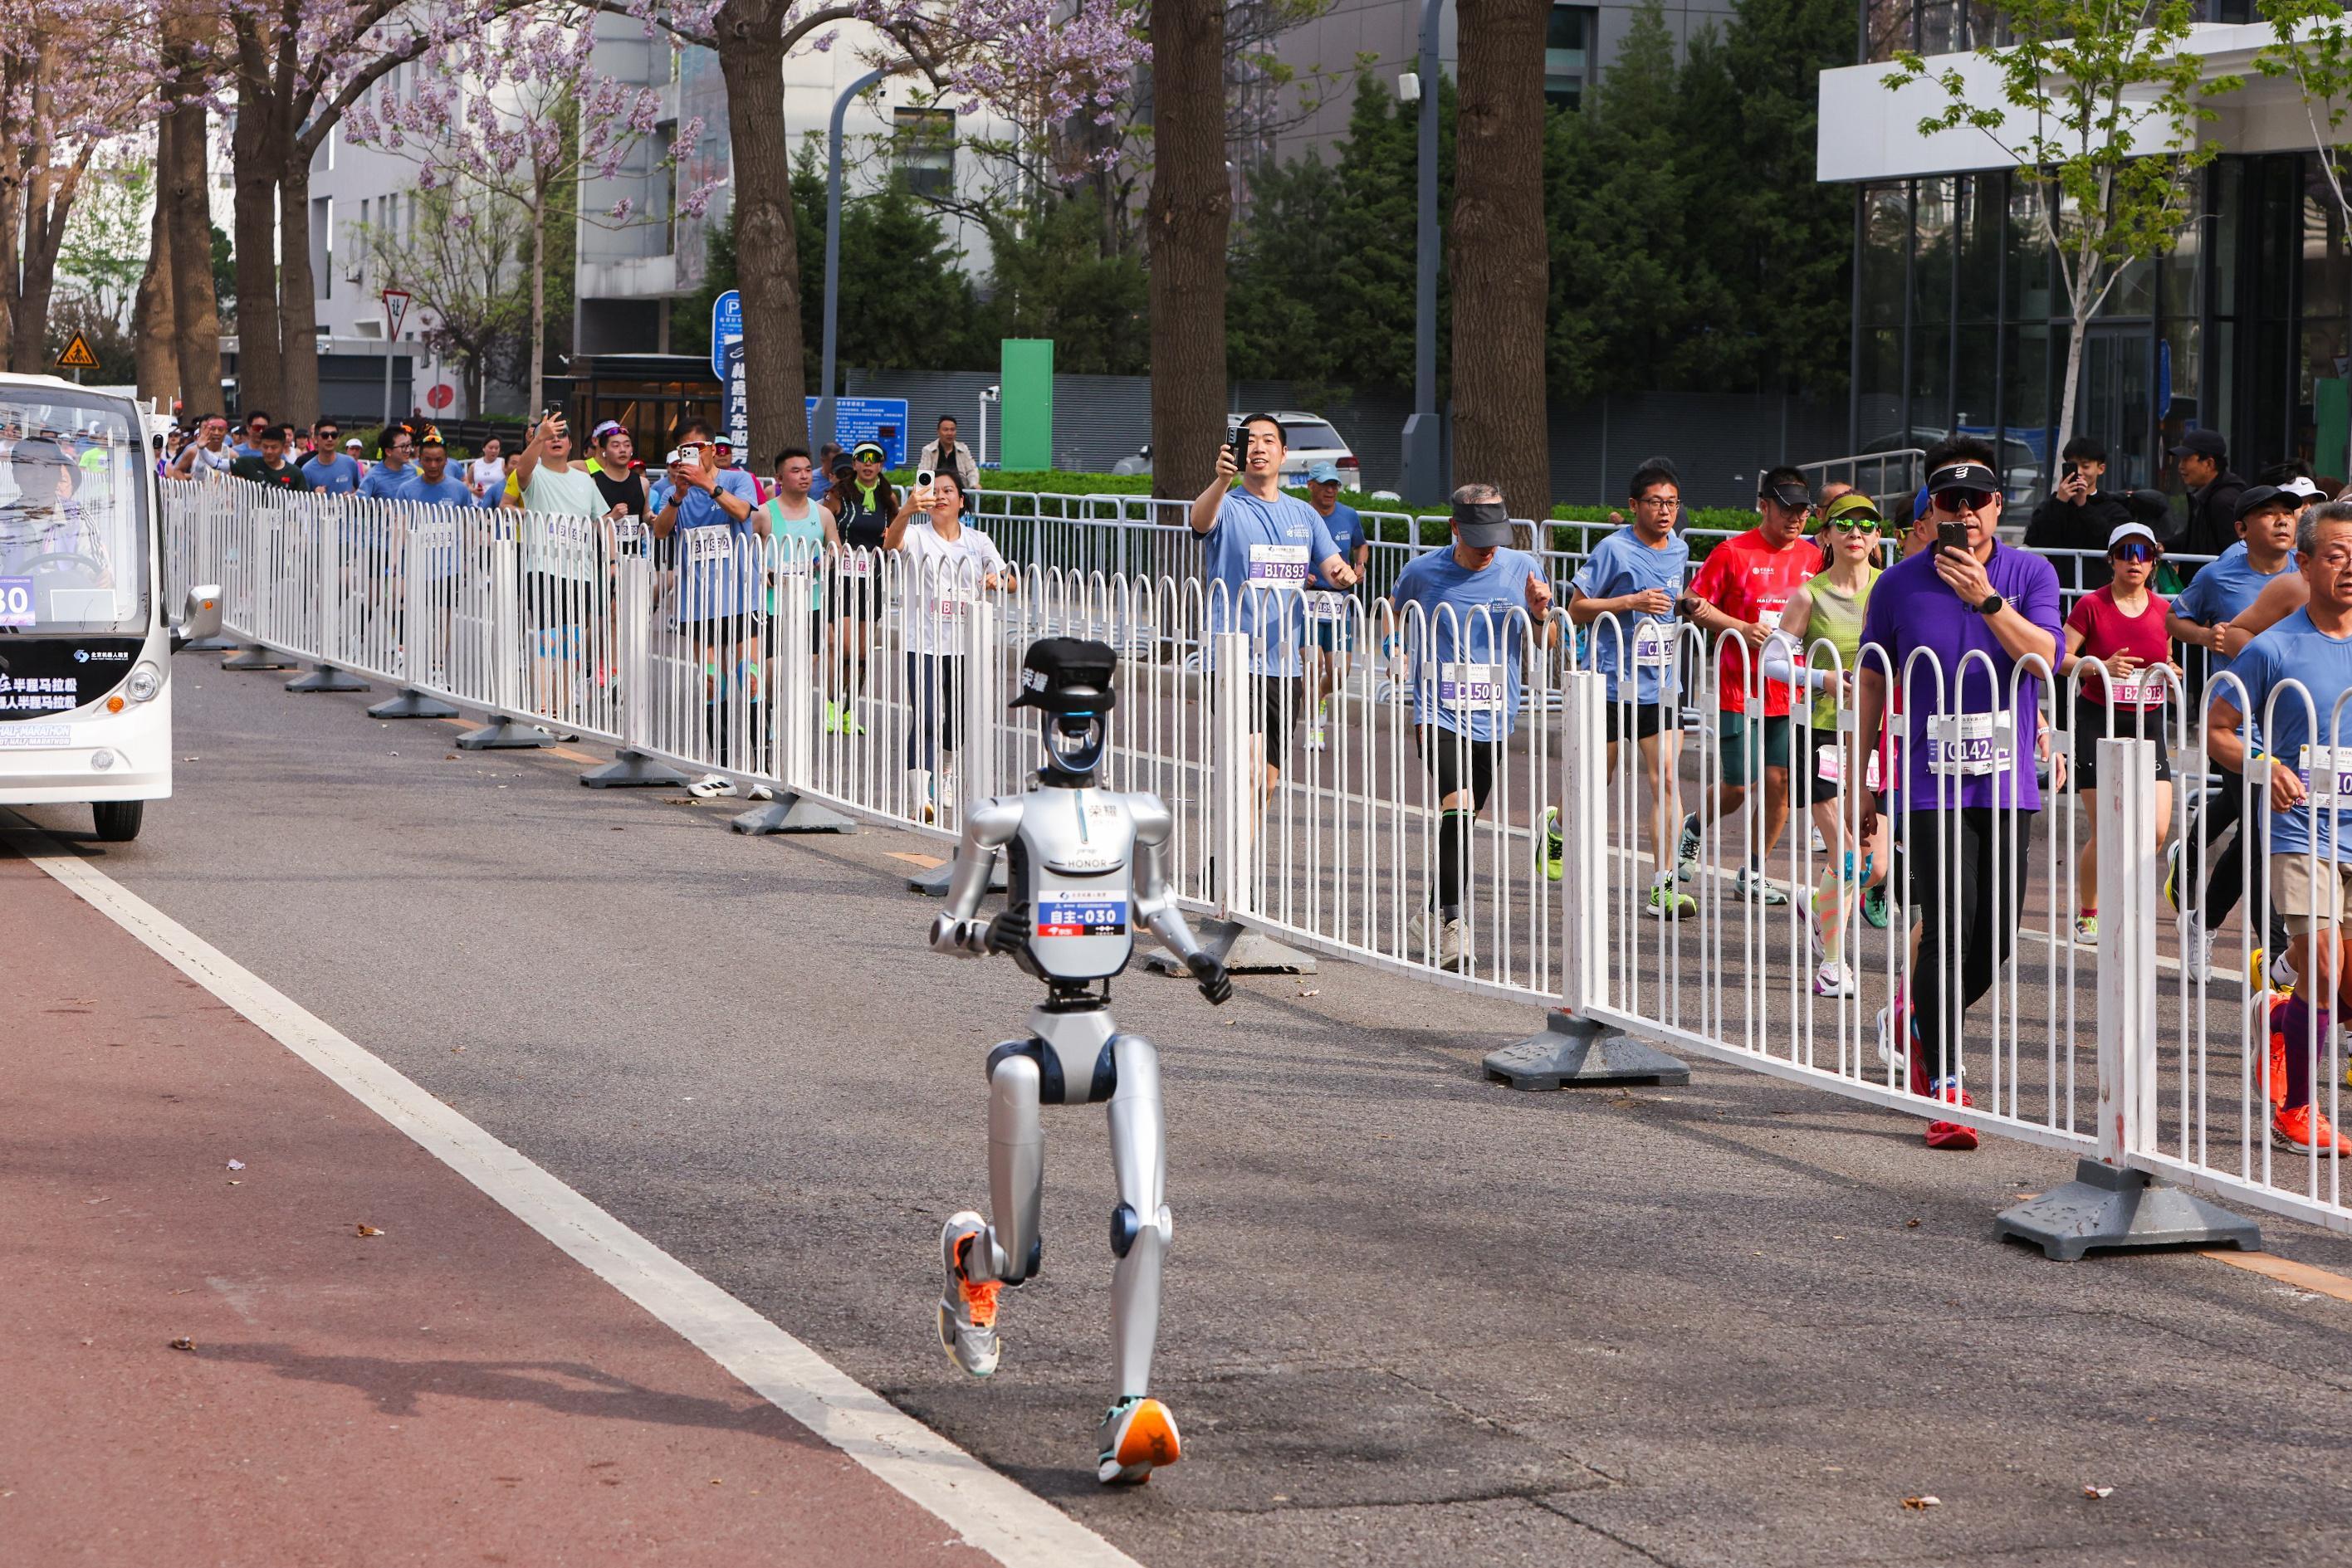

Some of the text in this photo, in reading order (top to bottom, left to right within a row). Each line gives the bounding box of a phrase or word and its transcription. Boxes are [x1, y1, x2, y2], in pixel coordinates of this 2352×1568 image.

[728, 301, 740, 314] P
[1264, 564, 1304, 578] B17893
[1022, 667, 1049, 692] 荣耀
[2125, 686, 2161, 701] B2913
[1068, 859, 1107, 868] HONOR
[1050, 910, 1117, 925] 自主-030
